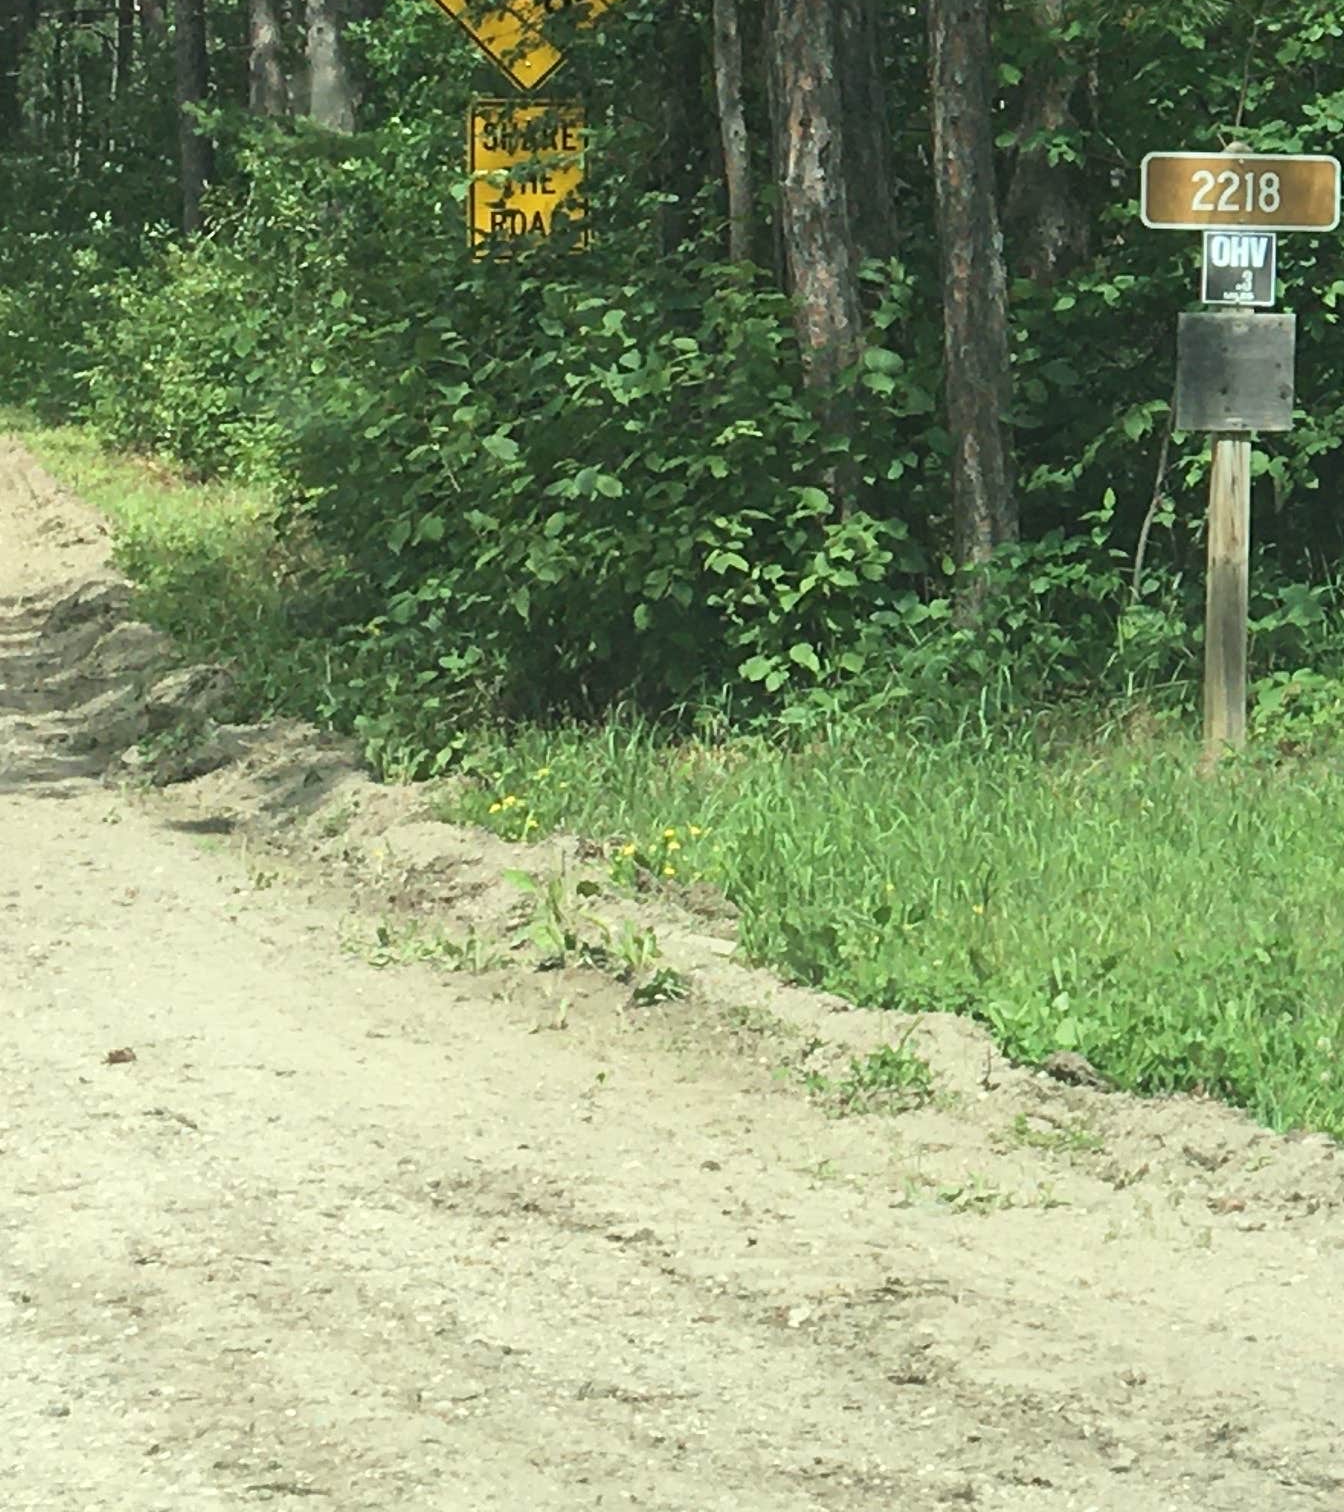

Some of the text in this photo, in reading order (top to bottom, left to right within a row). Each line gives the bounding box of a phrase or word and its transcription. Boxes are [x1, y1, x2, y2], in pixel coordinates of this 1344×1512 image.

[1191, 170, 1281, 213] 2218
[489, 209, 560, 239] ROA
[1211, 236, 1268, 268] OHV
